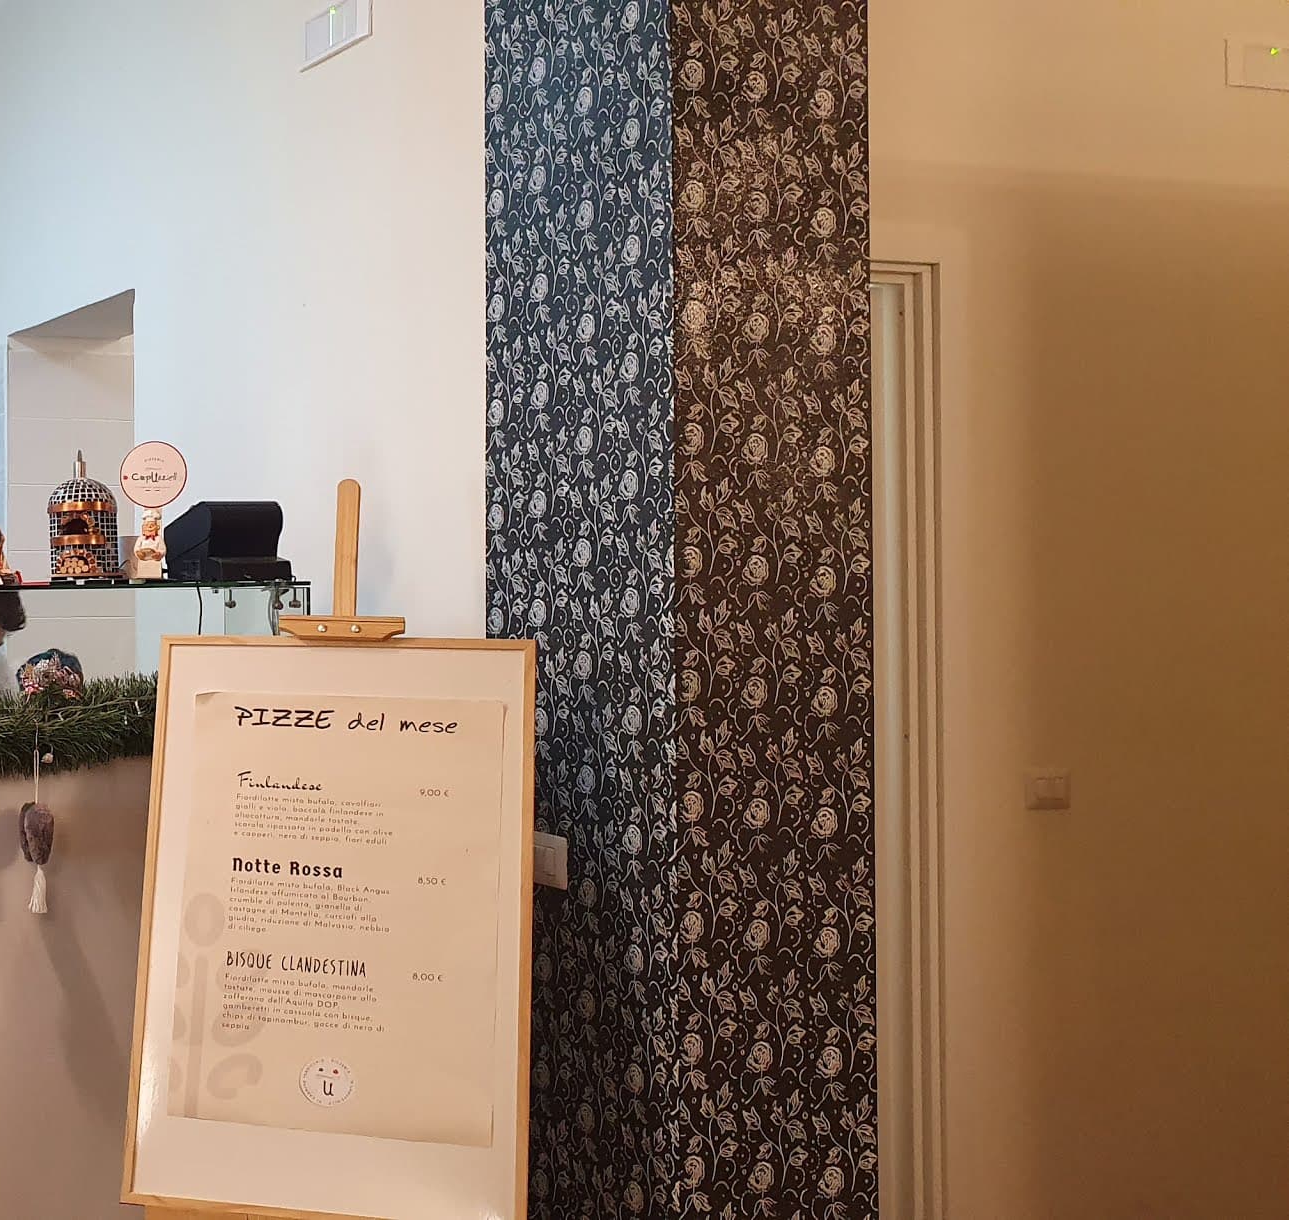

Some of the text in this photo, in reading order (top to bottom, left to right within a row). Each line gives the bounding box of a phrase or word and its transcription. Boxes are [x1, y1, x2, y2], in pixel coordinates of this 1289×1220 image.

[234, 706, 459, 734] PIZZE del mese
[237, 771, 323, 792] Finlandese
[419, 788, 441, 798] 9,00
[289, 861, 343, 879] Rossa
[417, 876, 438, 886] 8,50
[337, 884, 360, 893] Black
[363, 886, 390, 896] Angus
[229, 896, 263, 905] crumble
[226, 950, 367, 977] BISQUE CLANDESTINA
[259, 987, 290, 996] mousse
